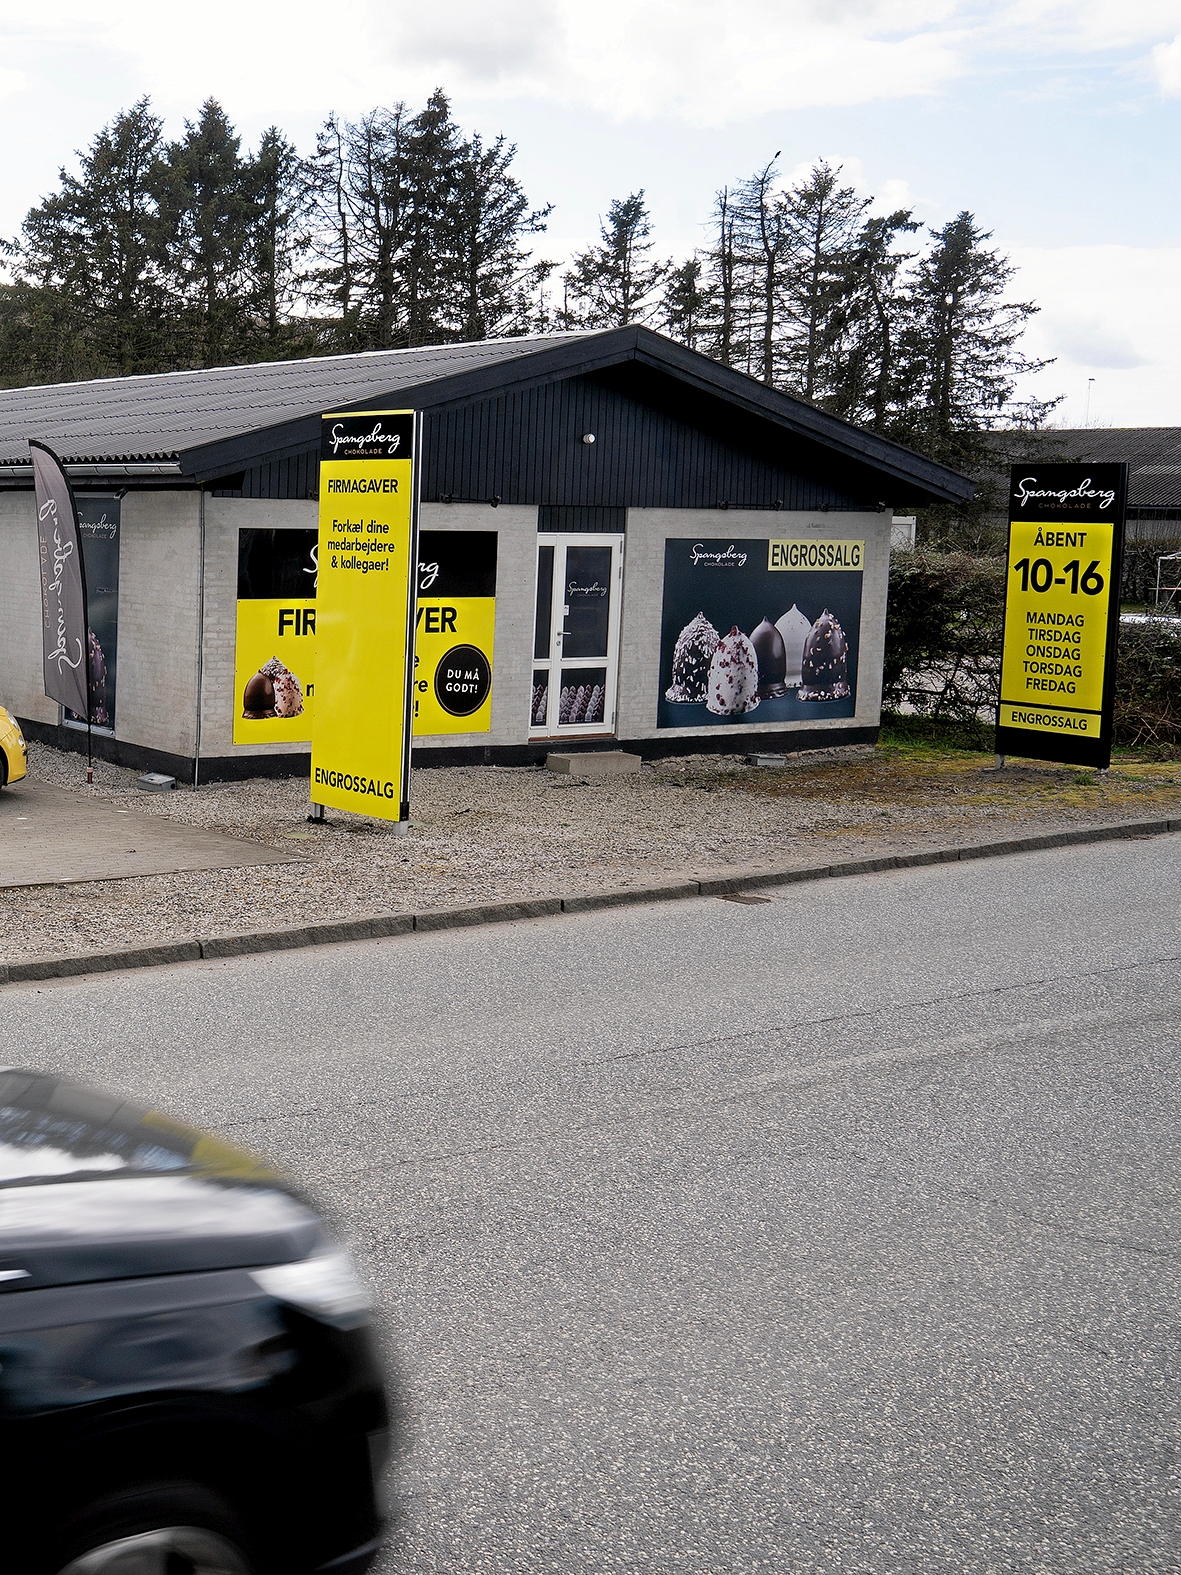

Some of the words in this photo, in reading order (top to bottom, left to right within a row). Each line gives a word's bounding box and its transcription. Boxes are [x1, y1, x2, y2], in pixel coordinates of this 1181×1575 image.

[329, 422, 401, 454] Spangsberg
[327, 479, 398, 494] FIRMAGAVER
[1013, 477, 1115, 509] Spangsberg
[332, 520, 363, 534] Forkæl
[366, 521, 389, 535] dine
[1033, 526, 1087, 548] ÅBENT
[327, 538, 395, 555] medarbejdere
[689, 543, 748, 566] Spangsberg
[331, 556, 338, 568] &
[340, 555, 390, 573] kollegaer!
[771, 544, 860, 567] ENGROSSALG
[1013, 558, 1104, 596] 10-16
[567, 581, 607, 596] Spangsberg
[1026, 611, 1085, 628] MANDAG
[1028, 628, 1081, 644] TIRSDAG
[1025, 644, 1081, 661] ONSDAG
[447, 669, 461, 679] DU
[464, 667, 480, 681] MÅ
[1023, 660, 1082, 677] TORSDAG
[446, 682, 478, 693] GODT!
[1025, 677, 1076, 694] FREDAG
[1011, 711, 1087, 731] ENGROSSALG
[315, 767, 394, 799] ENGROSSALG
